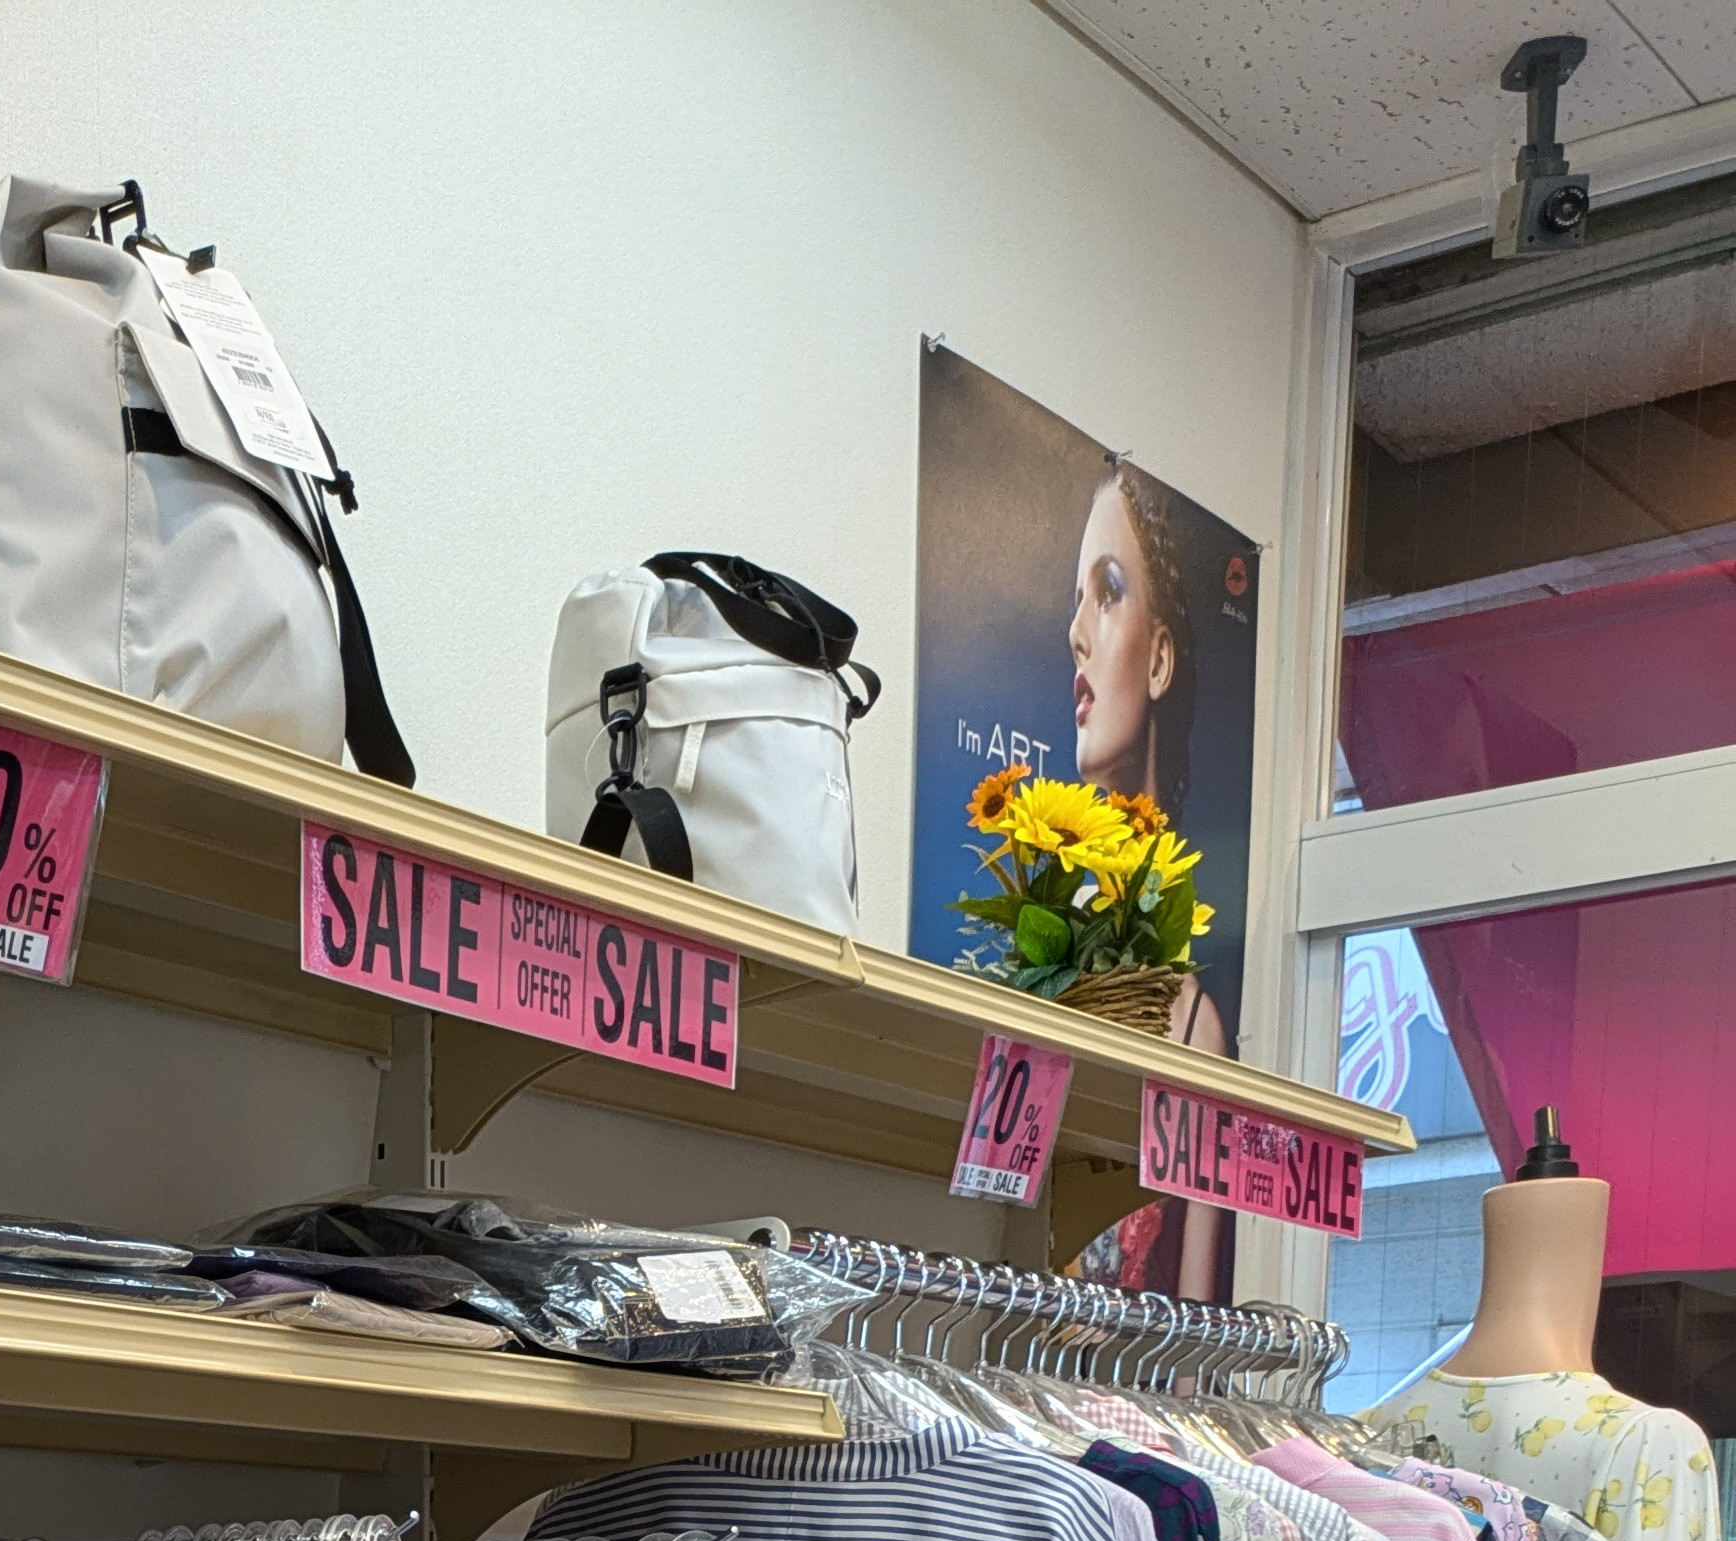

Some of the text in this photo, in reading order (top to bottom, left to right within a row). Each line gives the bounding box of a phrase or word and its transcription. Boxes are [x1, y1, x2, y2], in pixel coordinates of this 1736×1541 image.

[986, 723, 1052, 779] ART
[6, 883, 65, 931] OFF
[320, 834, 482, 1004] SALE
[510, 893, 582, 960] SPECIAL
[516, 960, 572, 1020] OFFER
[593, 924, 731, 1073] SALE
[1008, 1142, 1041, 1173] OFF
[1150, 1090, 1233, 1197] SALE
[992, 1173, 1023, 1196] SALE
[1244, 1169, 1274, 1209] OFFER
[1284, 1131, 1359, 1231] SALE
